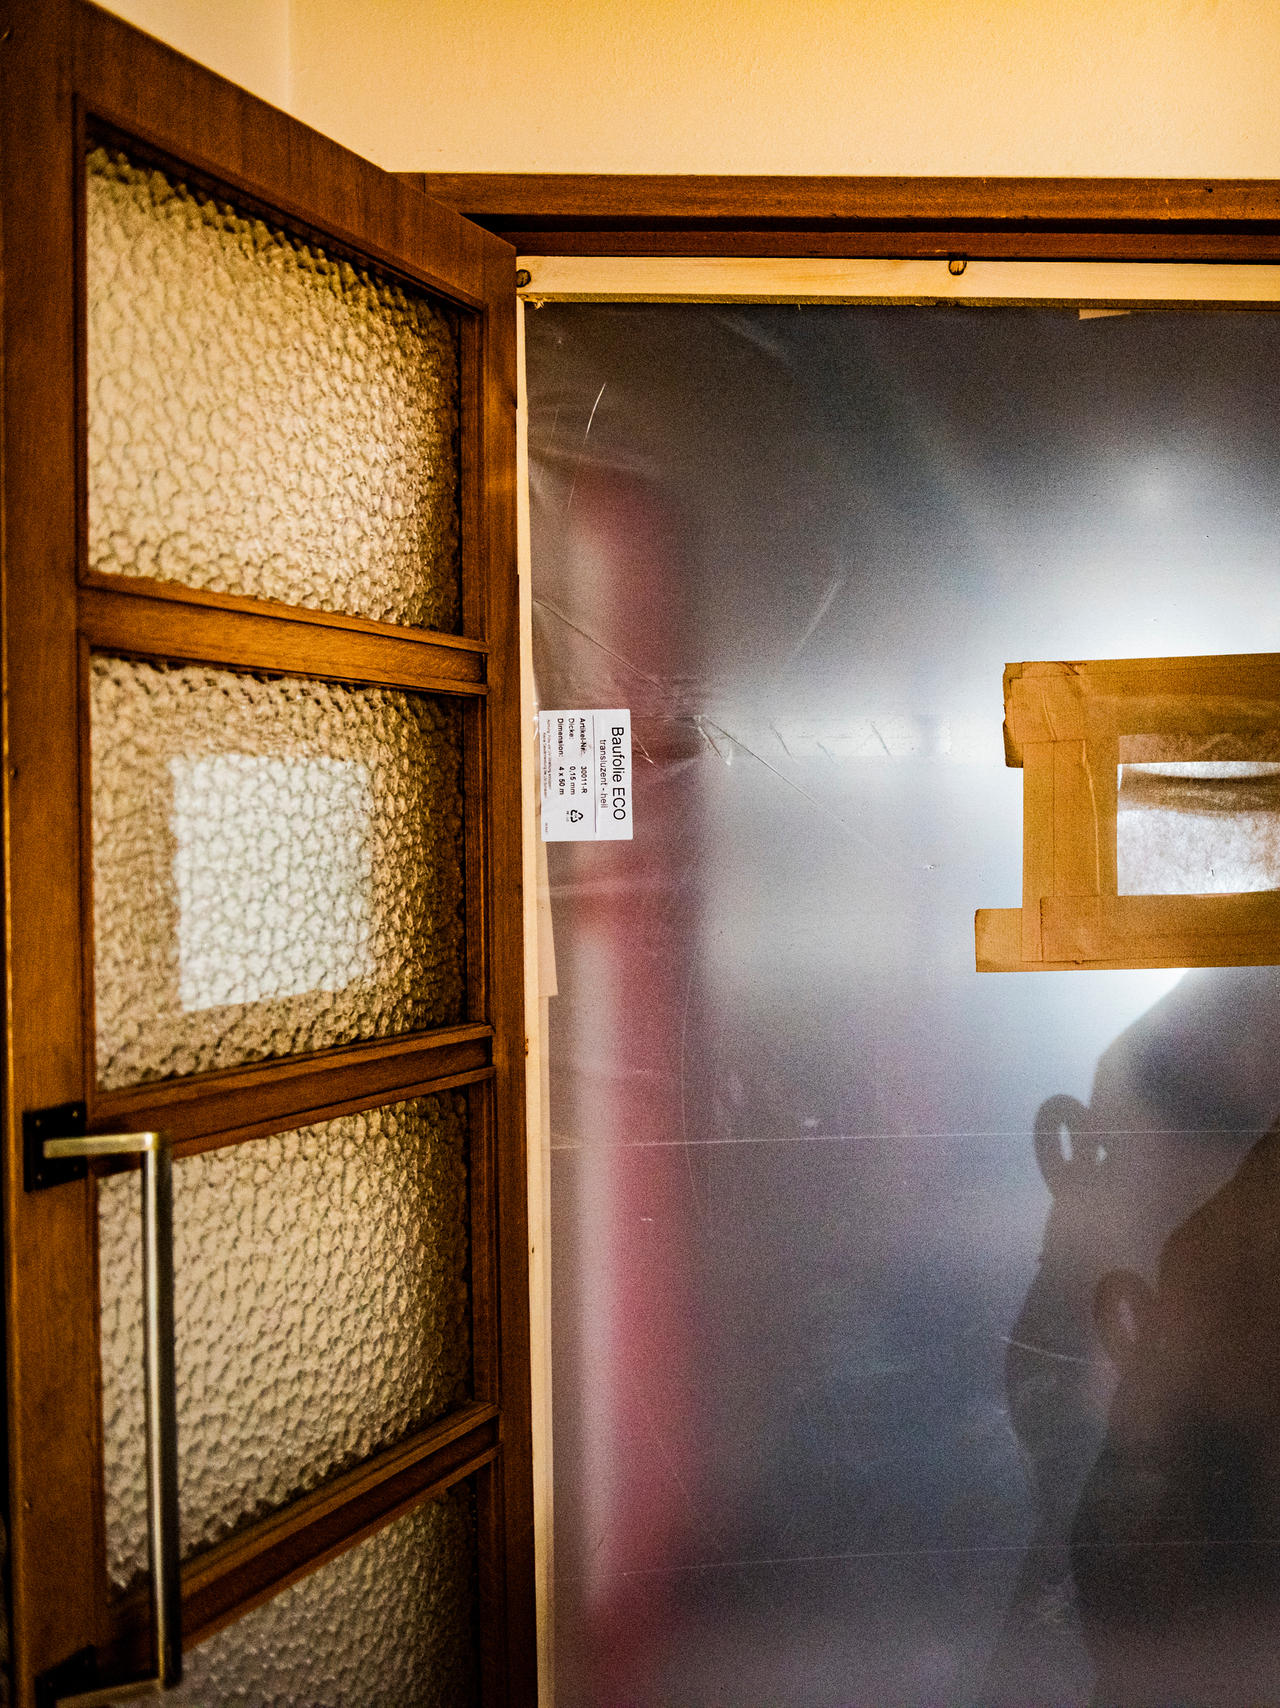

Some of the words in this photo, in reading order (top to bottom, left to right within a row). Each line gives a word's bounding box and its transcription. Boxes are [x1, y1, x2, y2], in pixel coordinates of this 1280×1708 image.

[612, 727, 625, 783] Baufolie
[559, 779, 566, 787] 50
[570, 782, 575, 796] mm
[559, 788, 565, 796] m
[600, 793, 608, 809] hell
[612, 787, 626, 821] ECO
